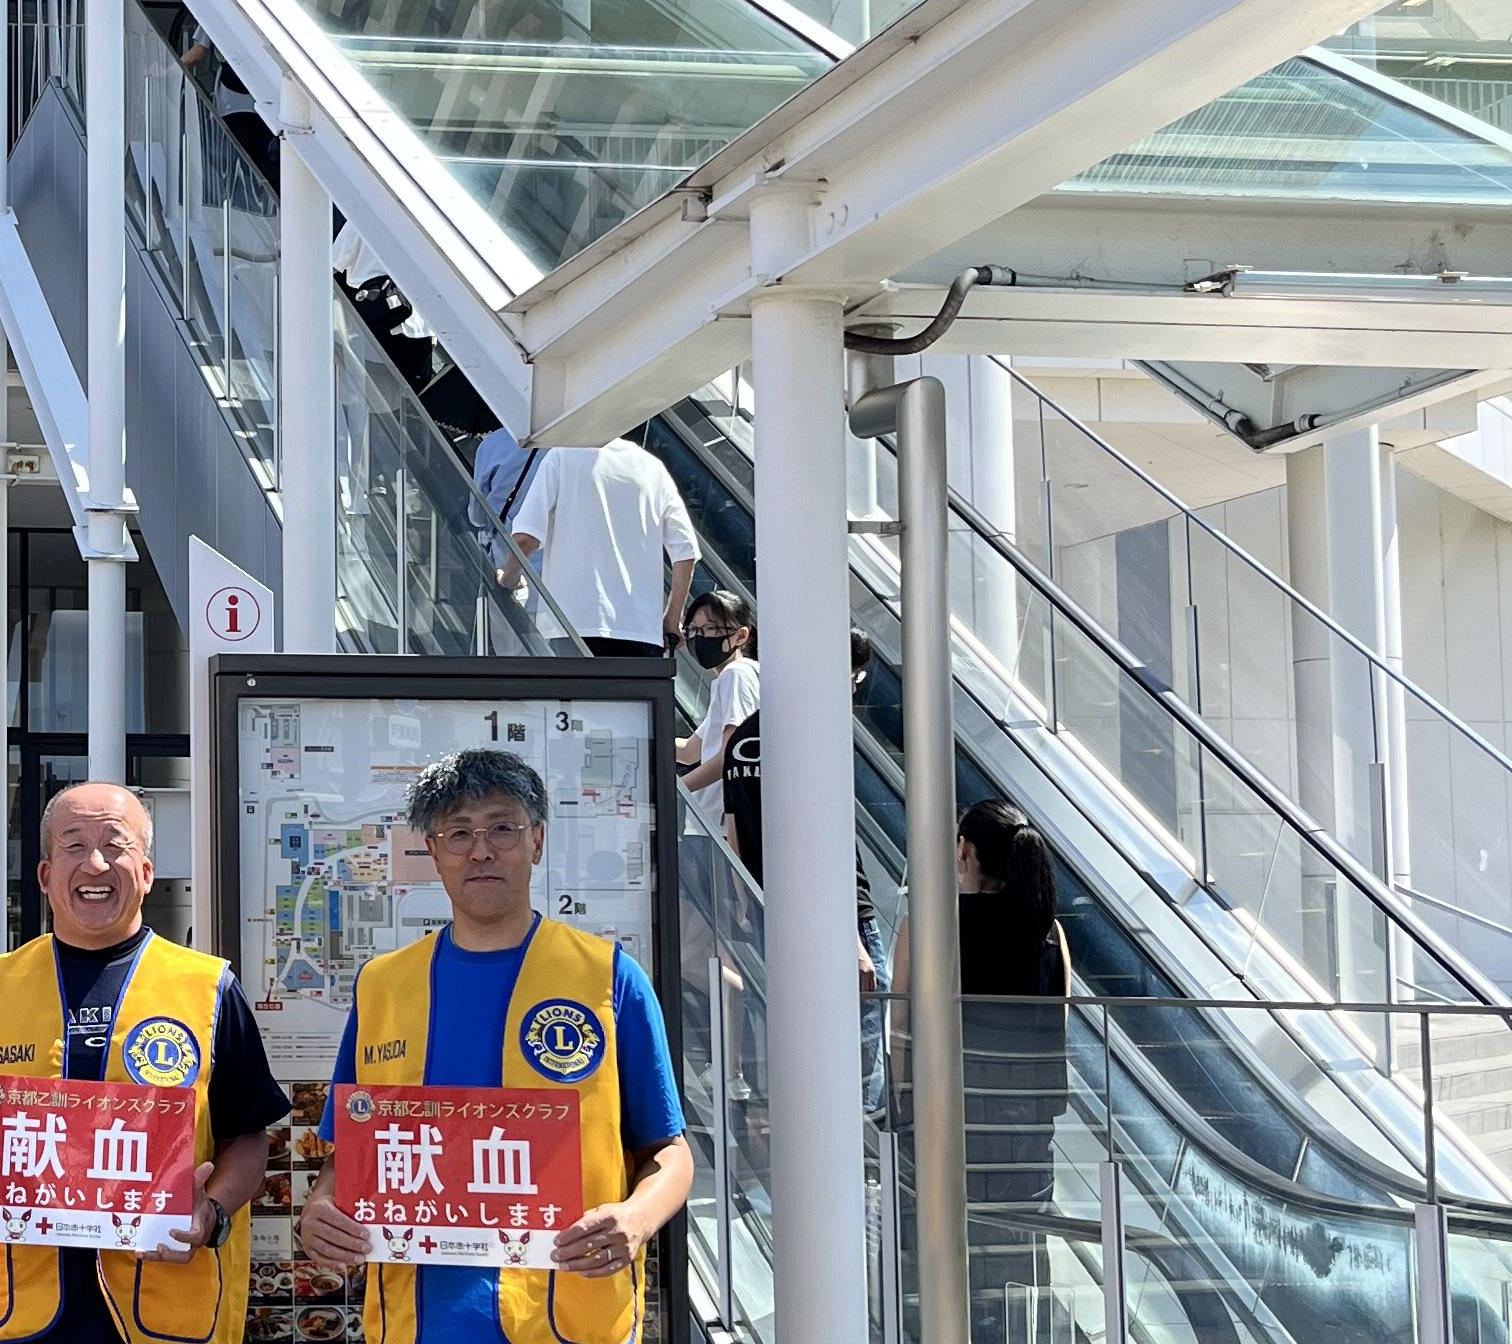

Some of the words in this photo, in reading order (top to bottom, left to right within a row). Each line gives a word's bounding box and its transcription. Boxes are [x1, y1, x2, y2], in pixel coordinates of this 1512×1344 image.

[538, 1007, 583, 1023] LIONS
[144, 1024, 184, 1042] LIONS
[553, 1026, 574, 1050] L
[154, 1041, 174, 1066] L
[7, 1088, 187, 1116] 京都乙訓ライオンズクラブ
[377, 1098, 572, 1121] 京都乙訓ライオンズクラブ
[1, 1110, 153, 1183] 献血
[375, 1122, 539, 1196] 献血
[354, 1197, 563, 1229] おねがいします
